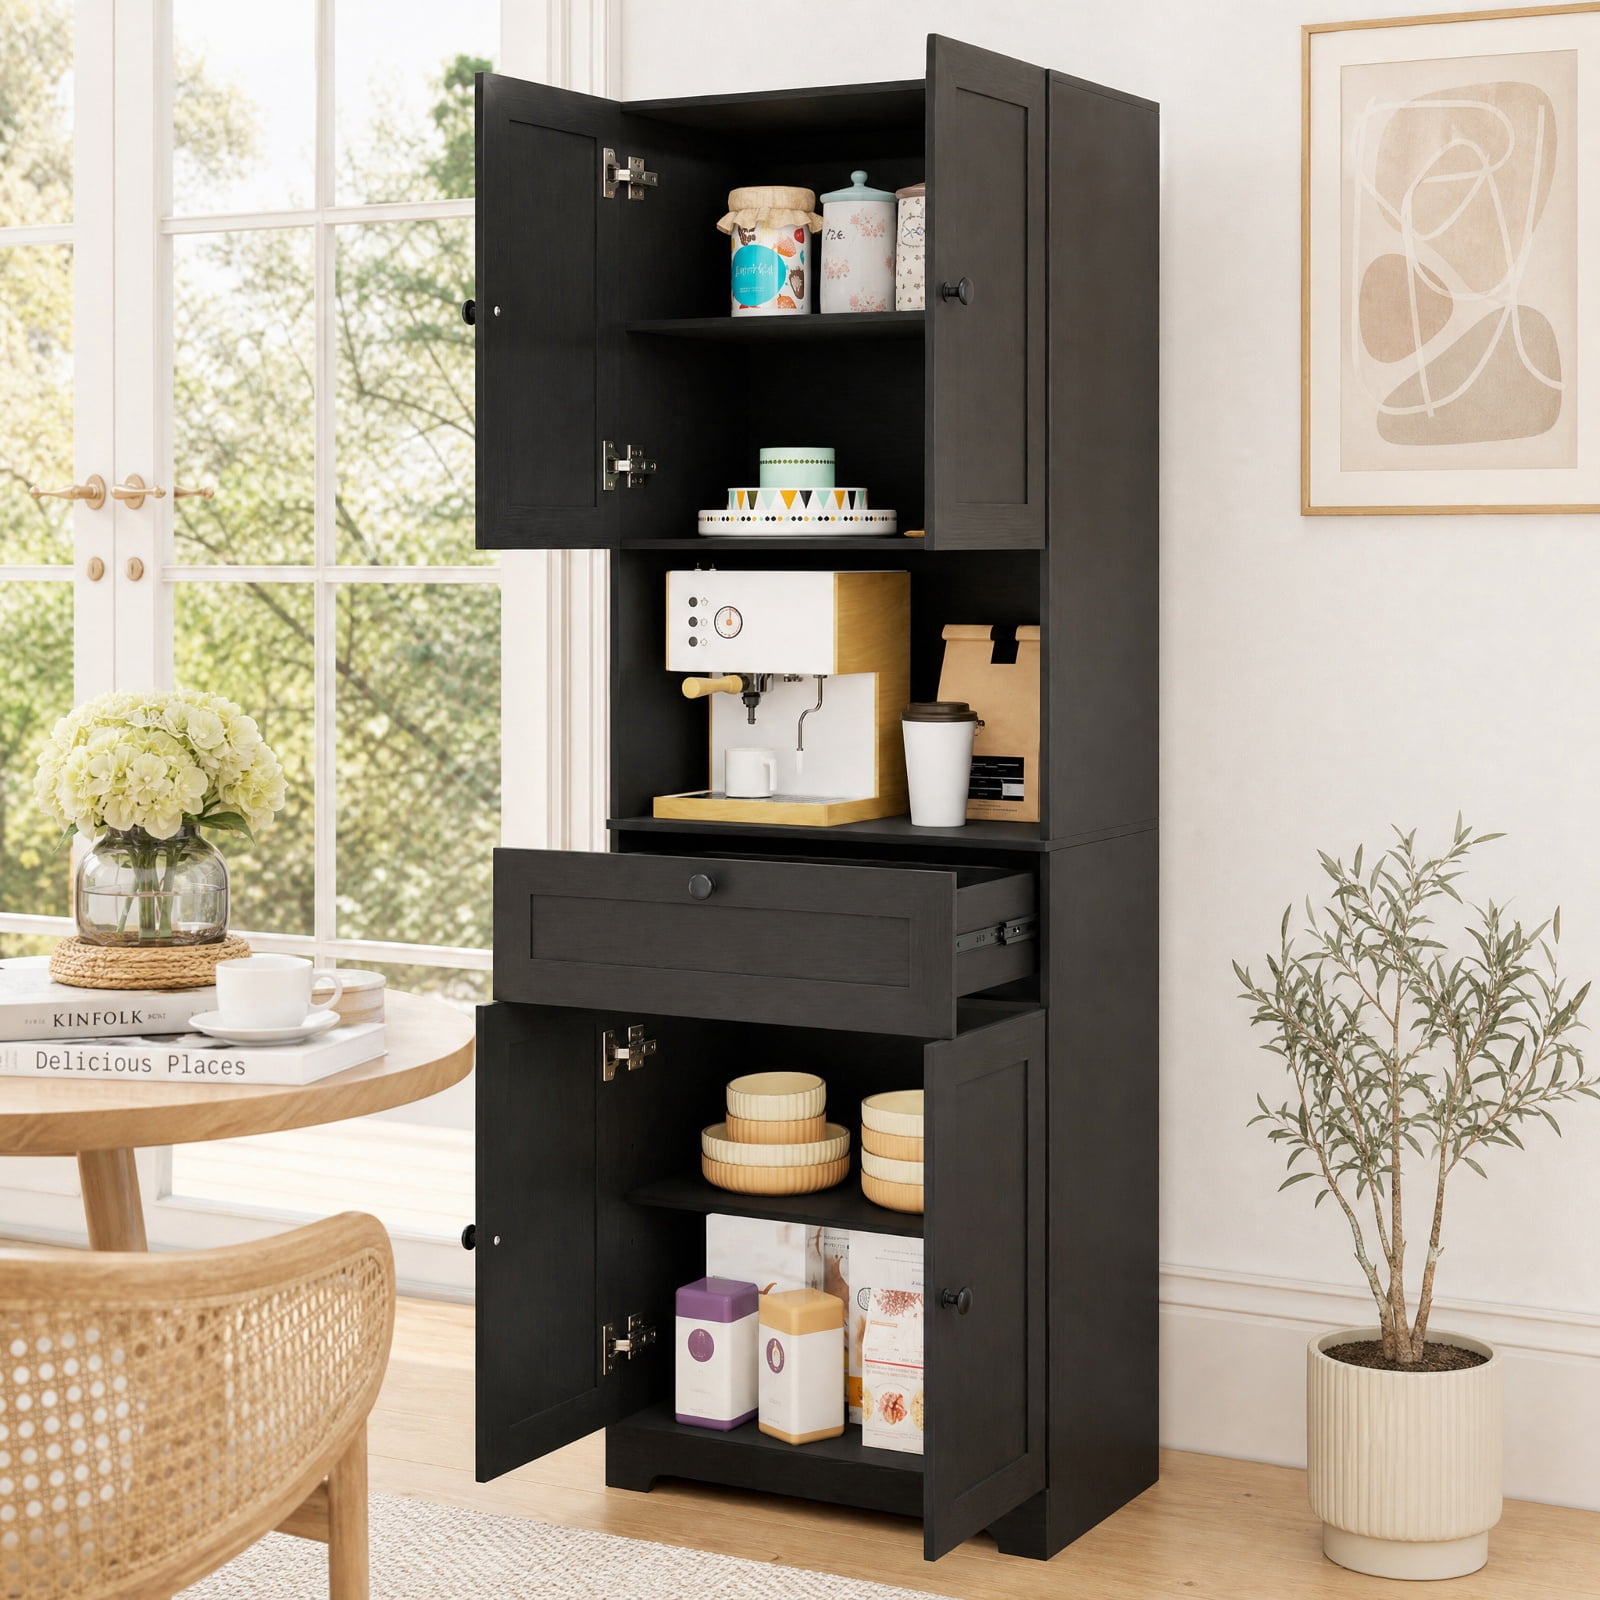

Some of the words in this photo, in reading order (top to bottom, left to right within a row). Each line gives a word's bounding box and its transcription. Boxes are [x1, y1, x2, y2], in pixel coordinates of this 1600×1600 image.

[53, 1010, 145, 1027] KINFOLK
[36, 1051, 152, 1073] Delicious
[168, 1054, 246, 1076] Places
